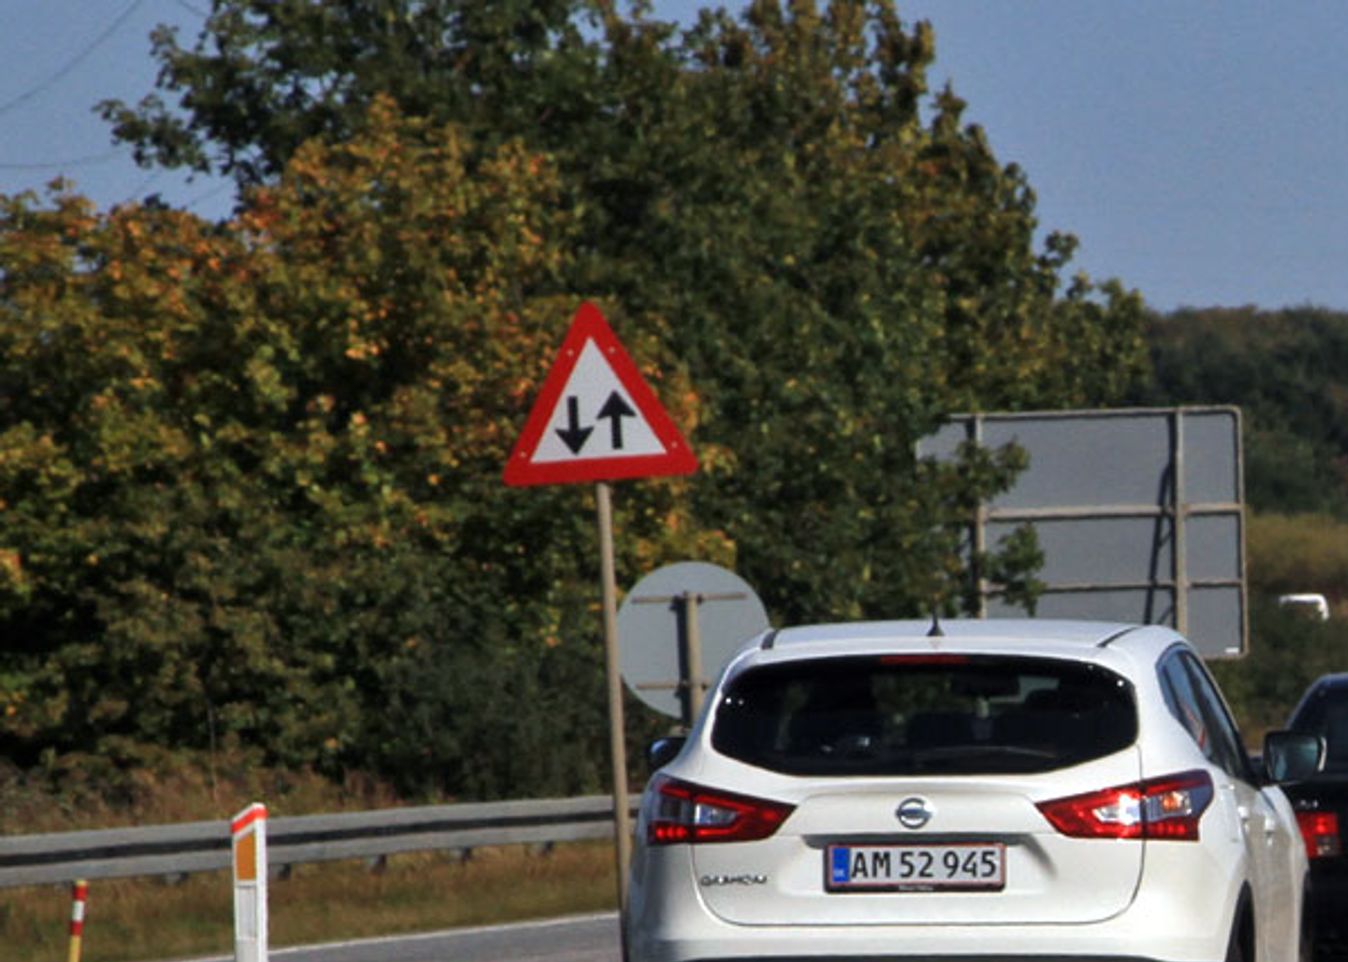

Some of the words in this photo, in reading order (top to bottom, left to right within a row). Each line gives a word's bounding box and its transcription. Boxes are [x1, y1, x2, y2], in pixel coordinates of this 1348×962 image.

[851, 851, 891, 878] AM
[900, 851, 934, 878] 52
[943, 850, 997, 878] 945
